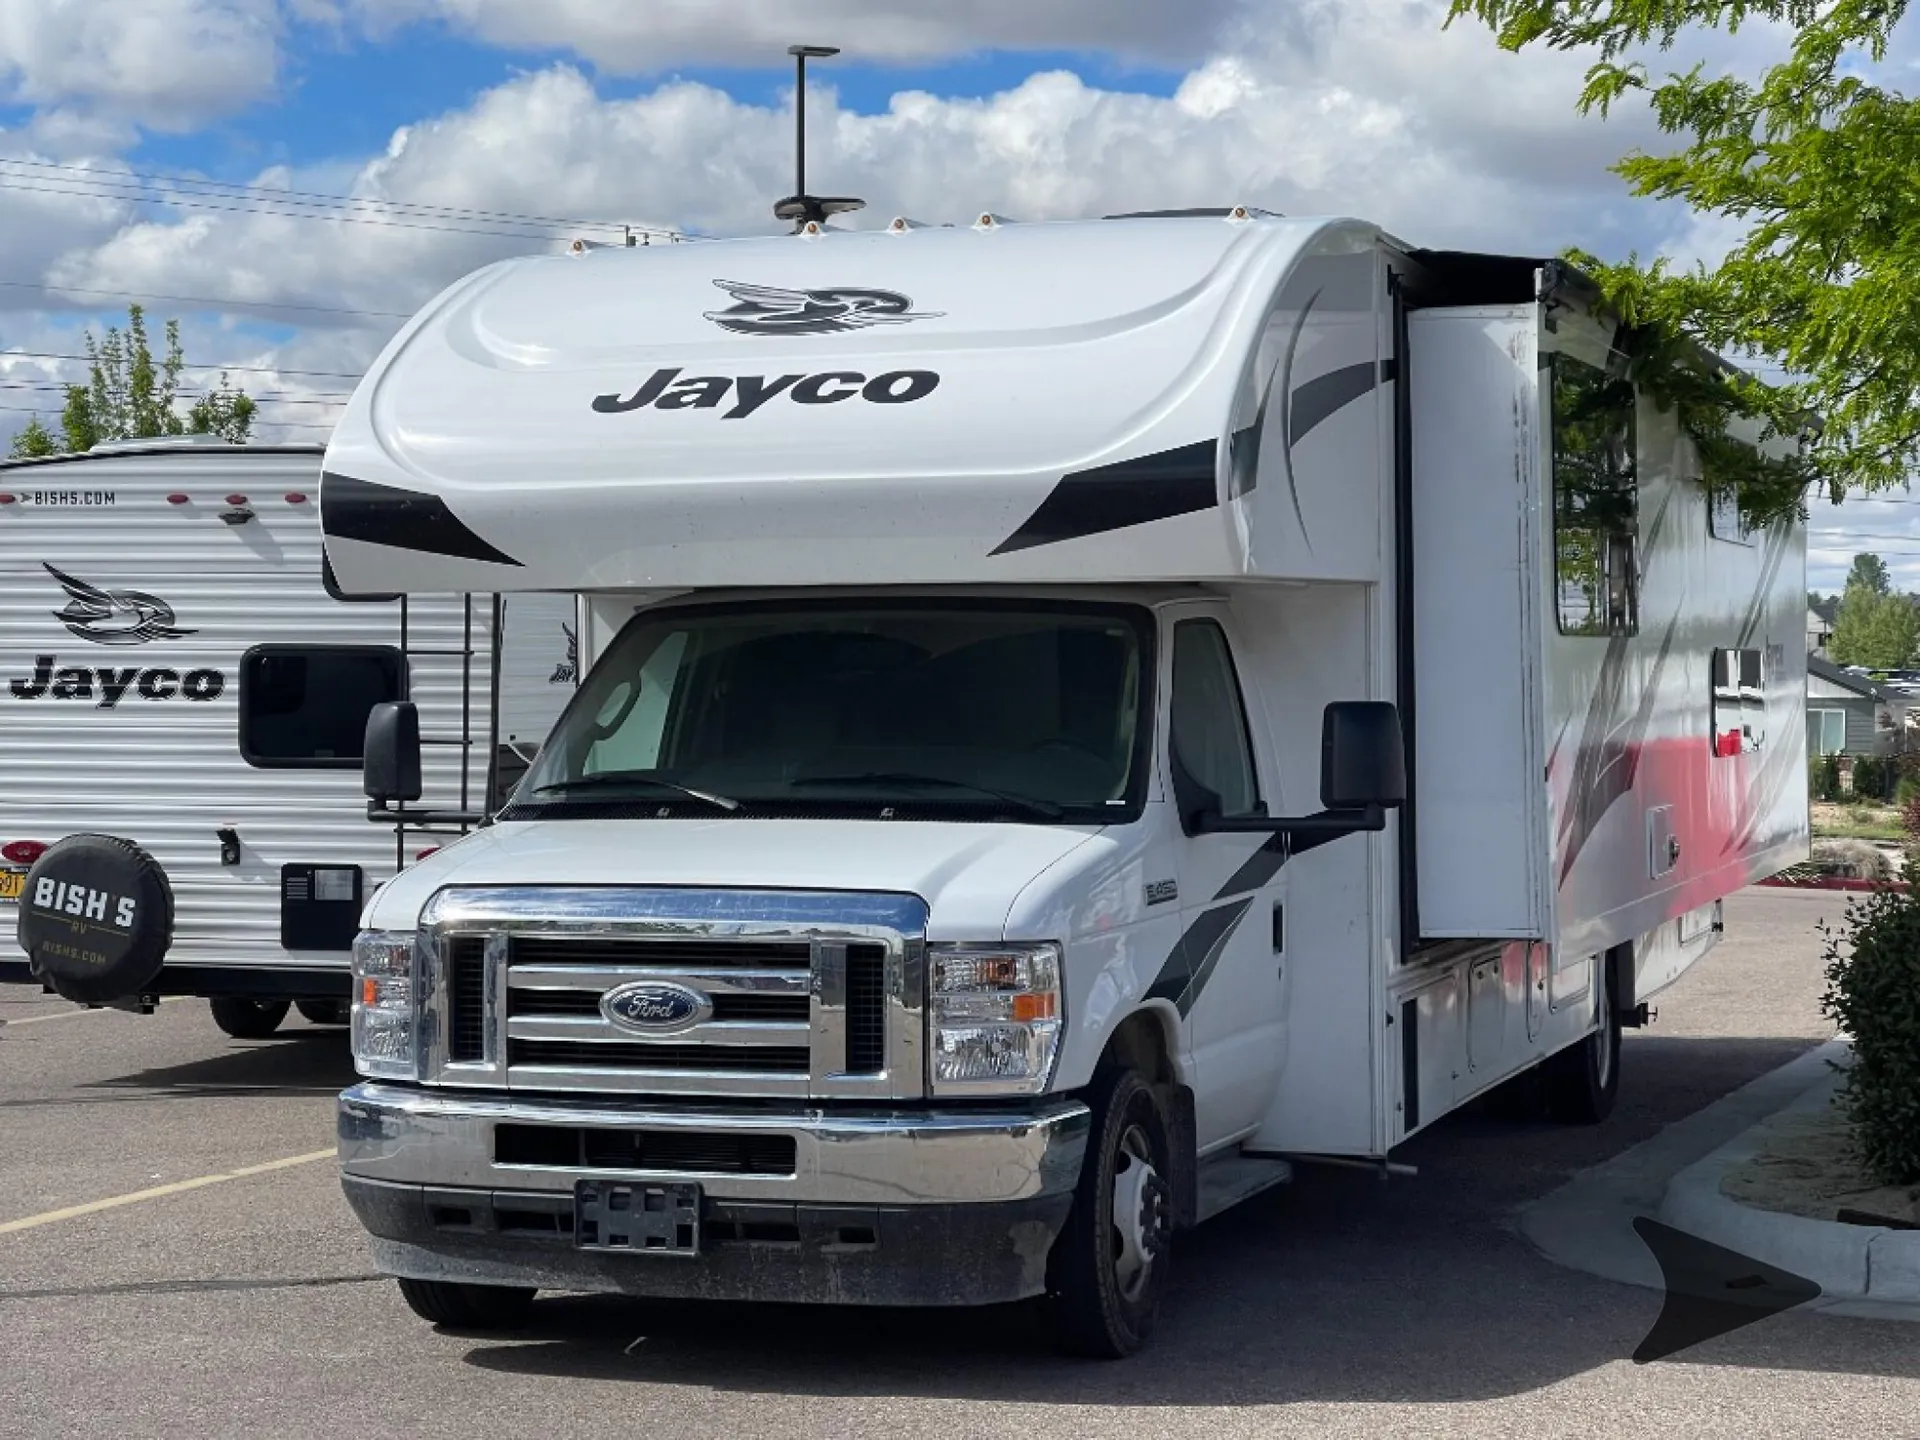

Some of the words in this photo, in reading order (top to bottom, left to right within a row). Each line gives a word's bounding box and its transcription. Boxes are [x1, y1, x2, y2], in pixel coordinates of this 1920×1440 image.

[591, 367, 941, 420] Jayco
[35, 491, 115, 505] BISHS.COM
[8, 654, 227, 710] Jayco
[70, 920, 88, 935] RV
[42, 940, 106, 965] BISHS.COM
[627, 995, 674, 1017] Ford
